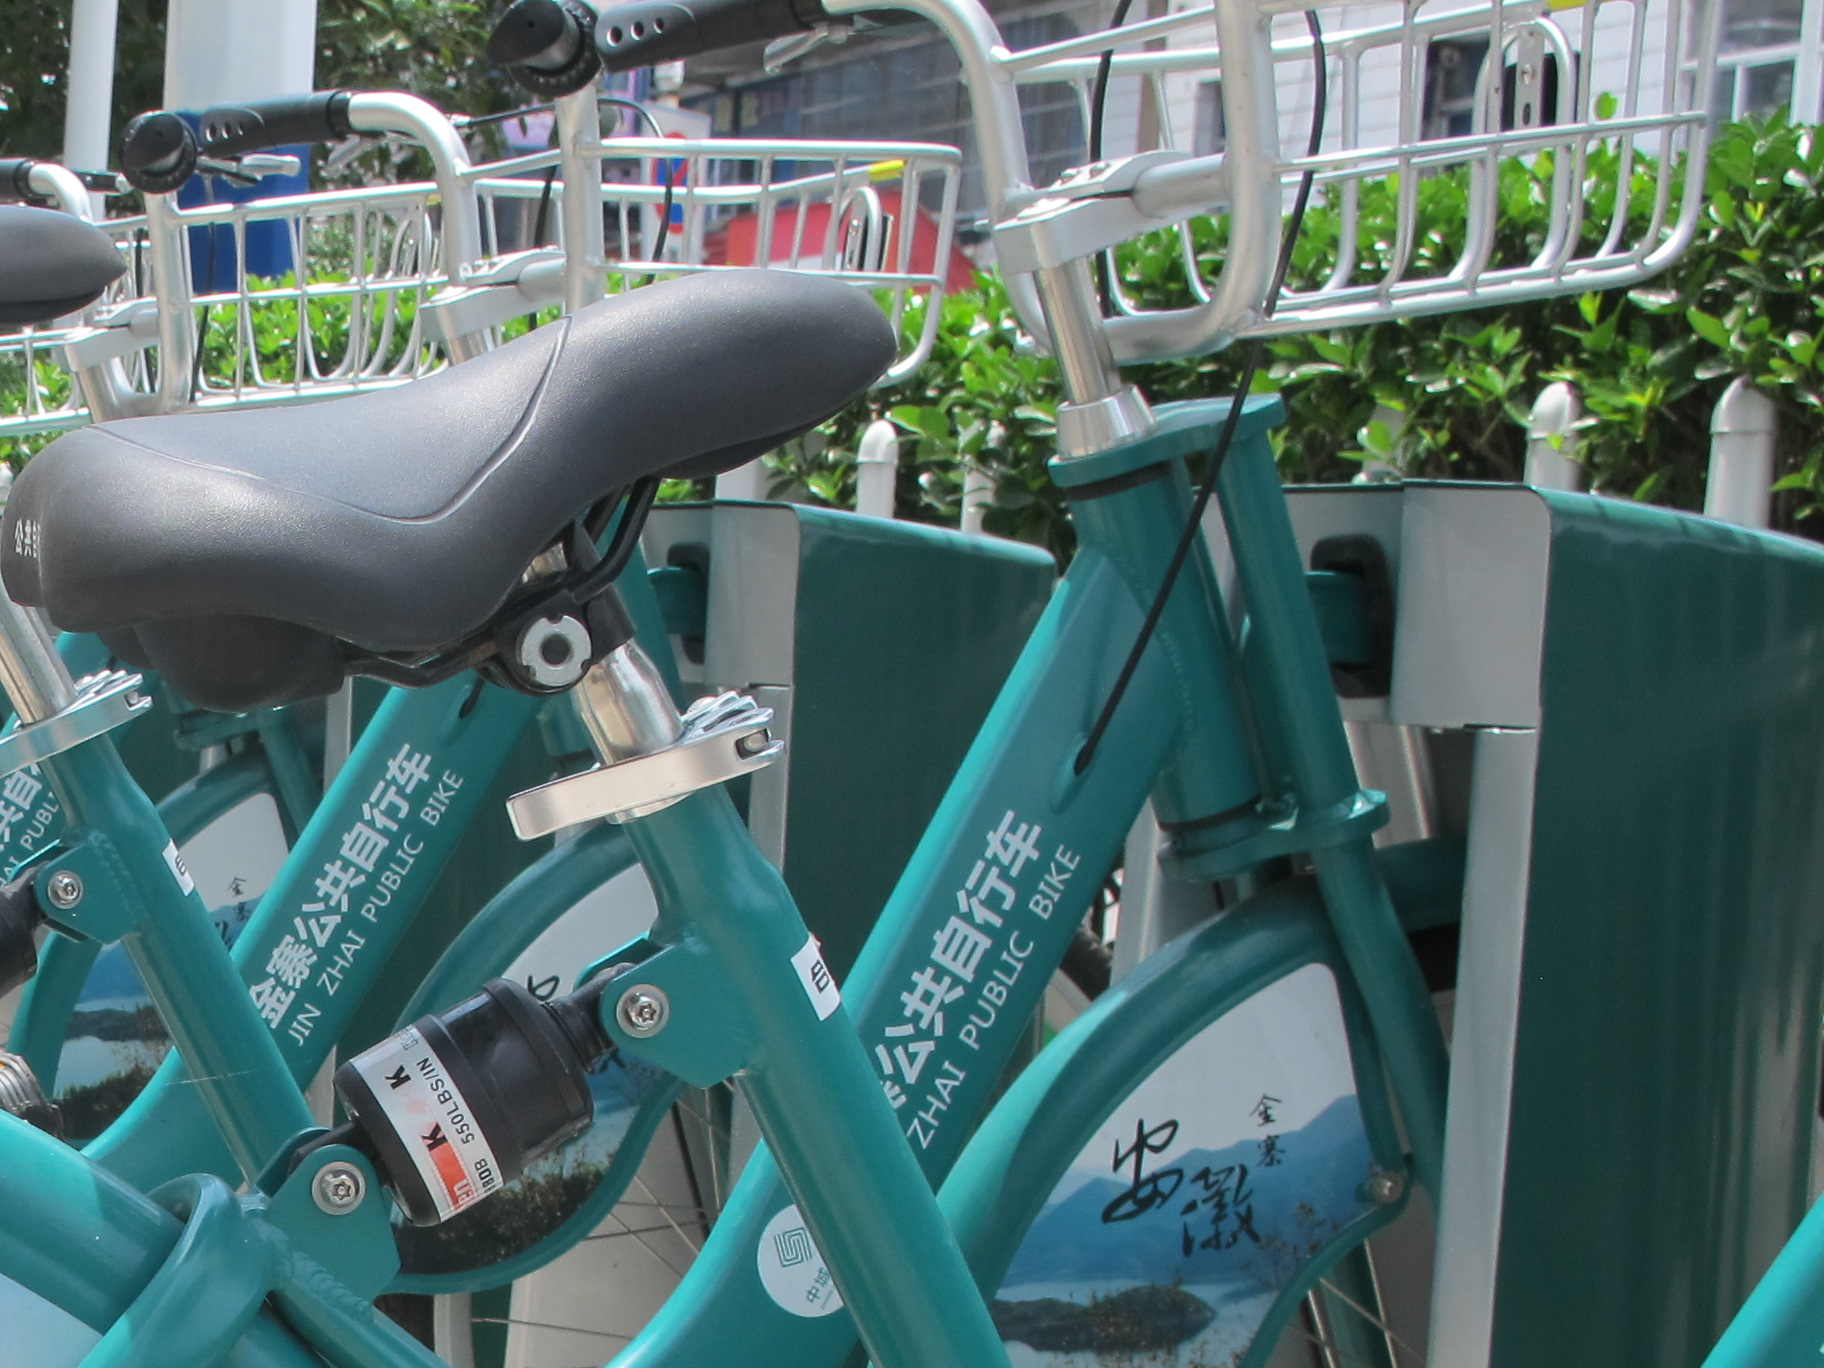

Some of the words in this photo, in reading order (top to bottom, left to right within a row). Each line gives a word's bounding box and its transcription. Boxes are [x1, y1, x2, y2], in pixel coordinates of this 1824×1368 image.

[19, 791, 60, 851] PUBL
[249, 743, 432, 1029] 金寨公共自行车
[288, 1002, 323, 1046] JIN
[316, 929, 366, 996] ZHAI
[360, 833, 425, 923] PUBLIC
[419, 769, 464, 826] BIKE
[875, 809, 1043, 1110] 公共自行车
[416, 1056, 476, 1145] 550LBS/IN
[906, 1060, 966, 1149] ZHAI
[958, 929, 1034, 1050] PUBLIC
[1028, 844, 1080, 920] BIKE
